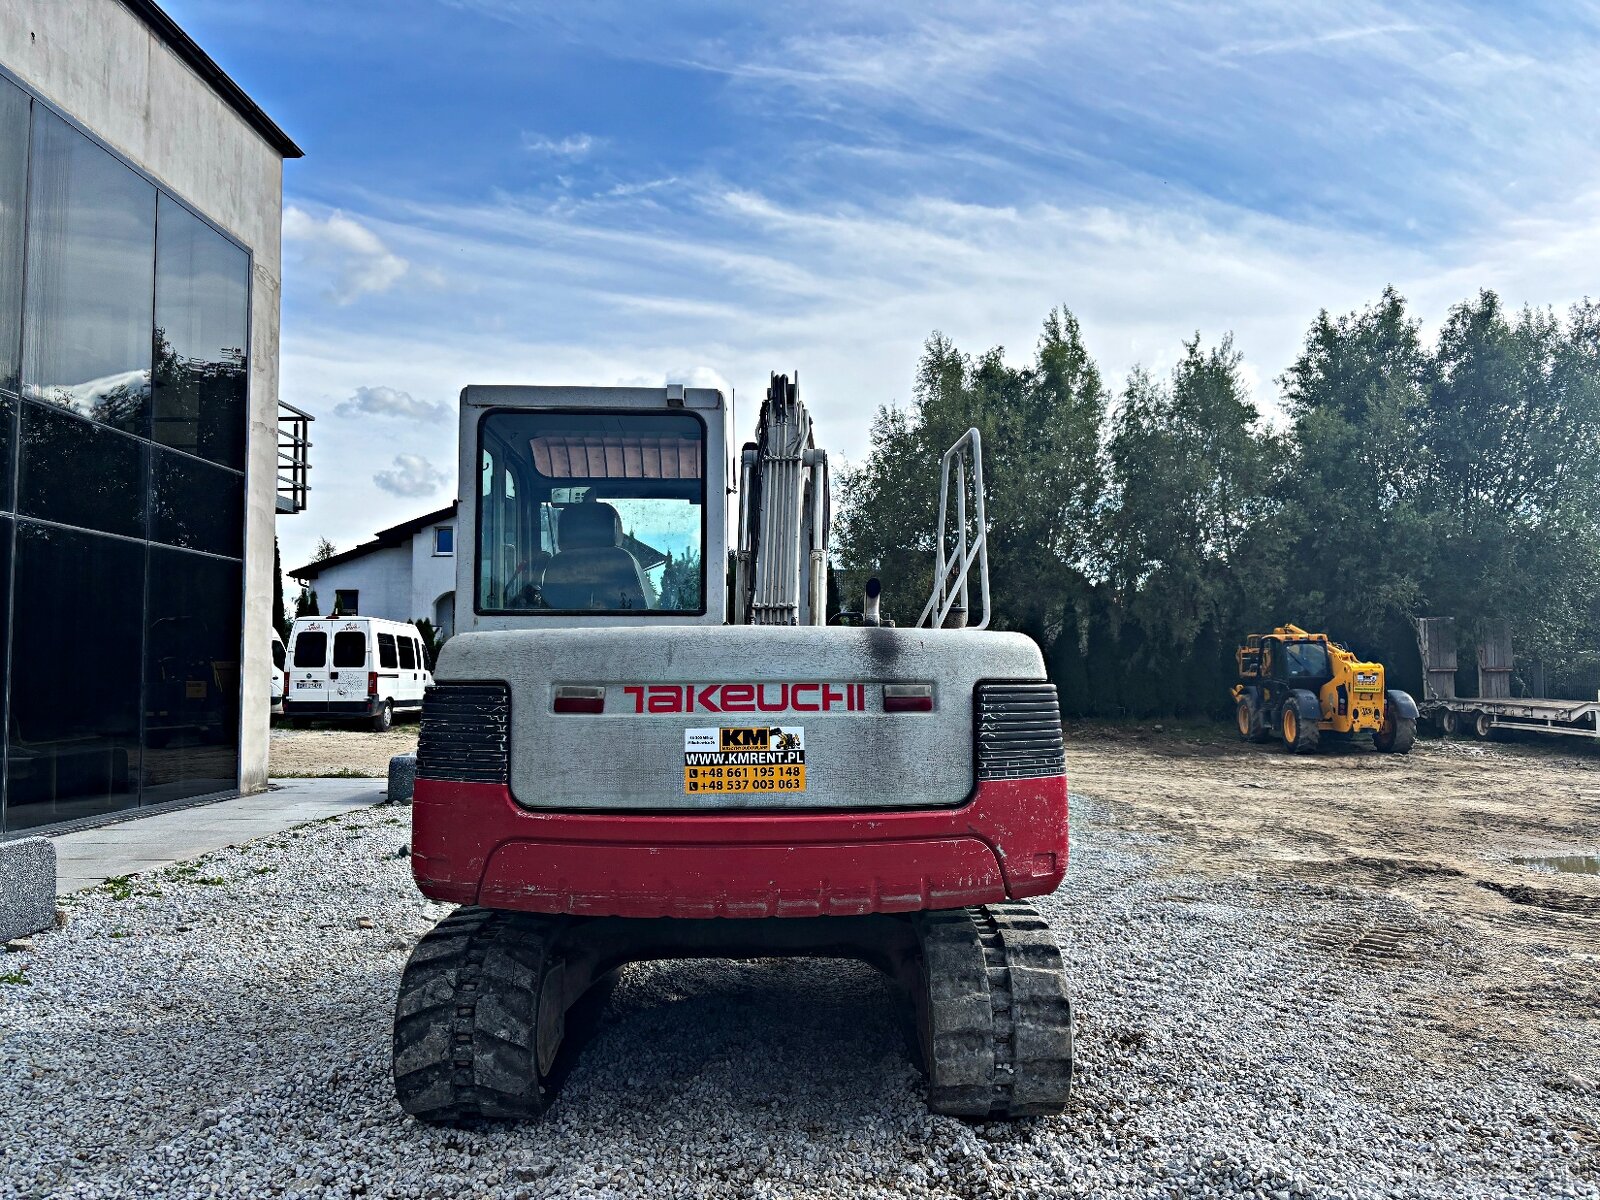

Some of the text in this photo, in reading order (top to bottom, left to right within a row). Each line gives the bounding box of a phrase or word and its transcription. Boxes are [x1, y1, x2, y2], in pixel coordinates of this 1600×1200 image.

[722, 729, 768, 746] KM
[686, 751, 804, 765] WWW.KMRENT.PL
[700, 766, 800, 778] +48 661 195 148
[700, 778, 800, 790] +48 537 003 063
